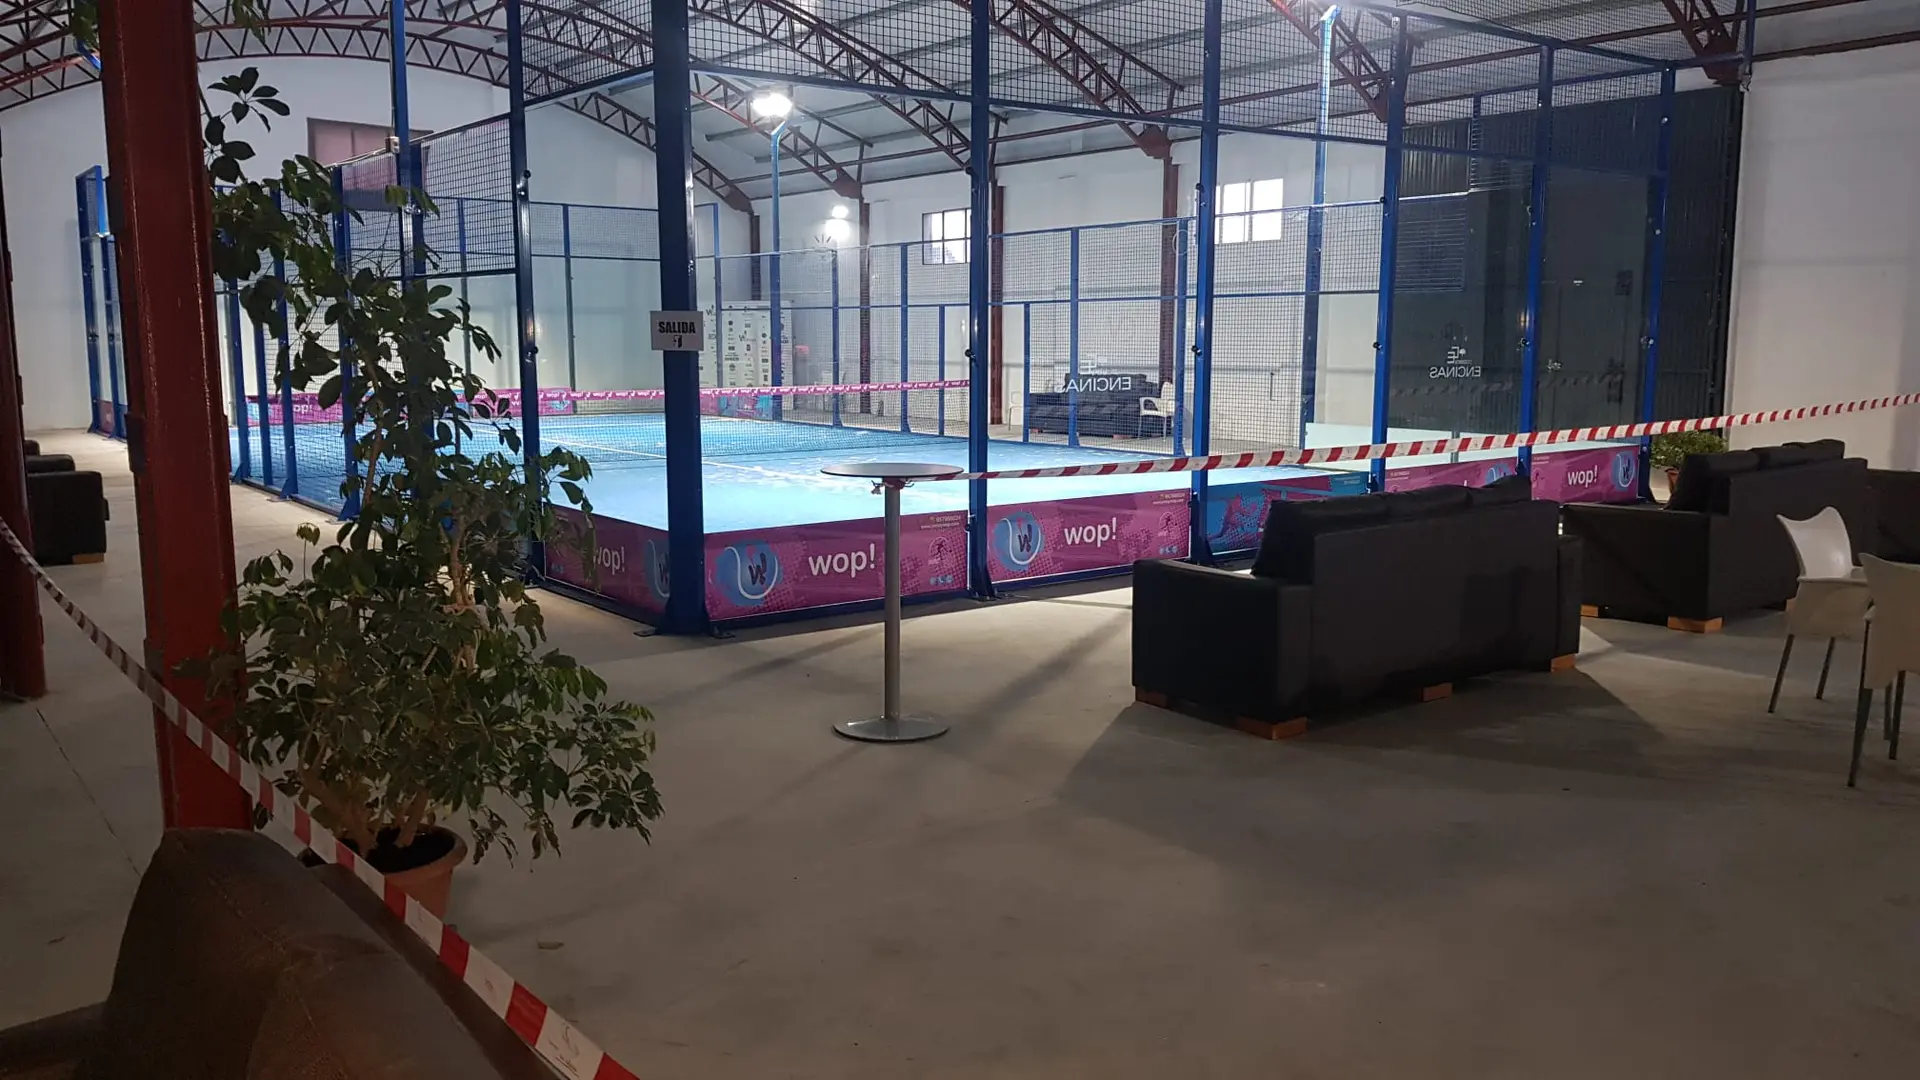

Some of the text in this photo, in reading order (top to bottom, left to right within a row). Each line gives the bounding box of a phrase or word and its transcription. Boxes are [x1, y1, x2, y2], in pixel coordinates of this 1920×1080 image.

[658, 321, 696, 334] SALIDA
[293, 404, 312, 414] op!
[1567, 464, 1598, 488] wop!
[1064, 517, 1117, 548] wop!
[808, 543, 876, 578] wop!
